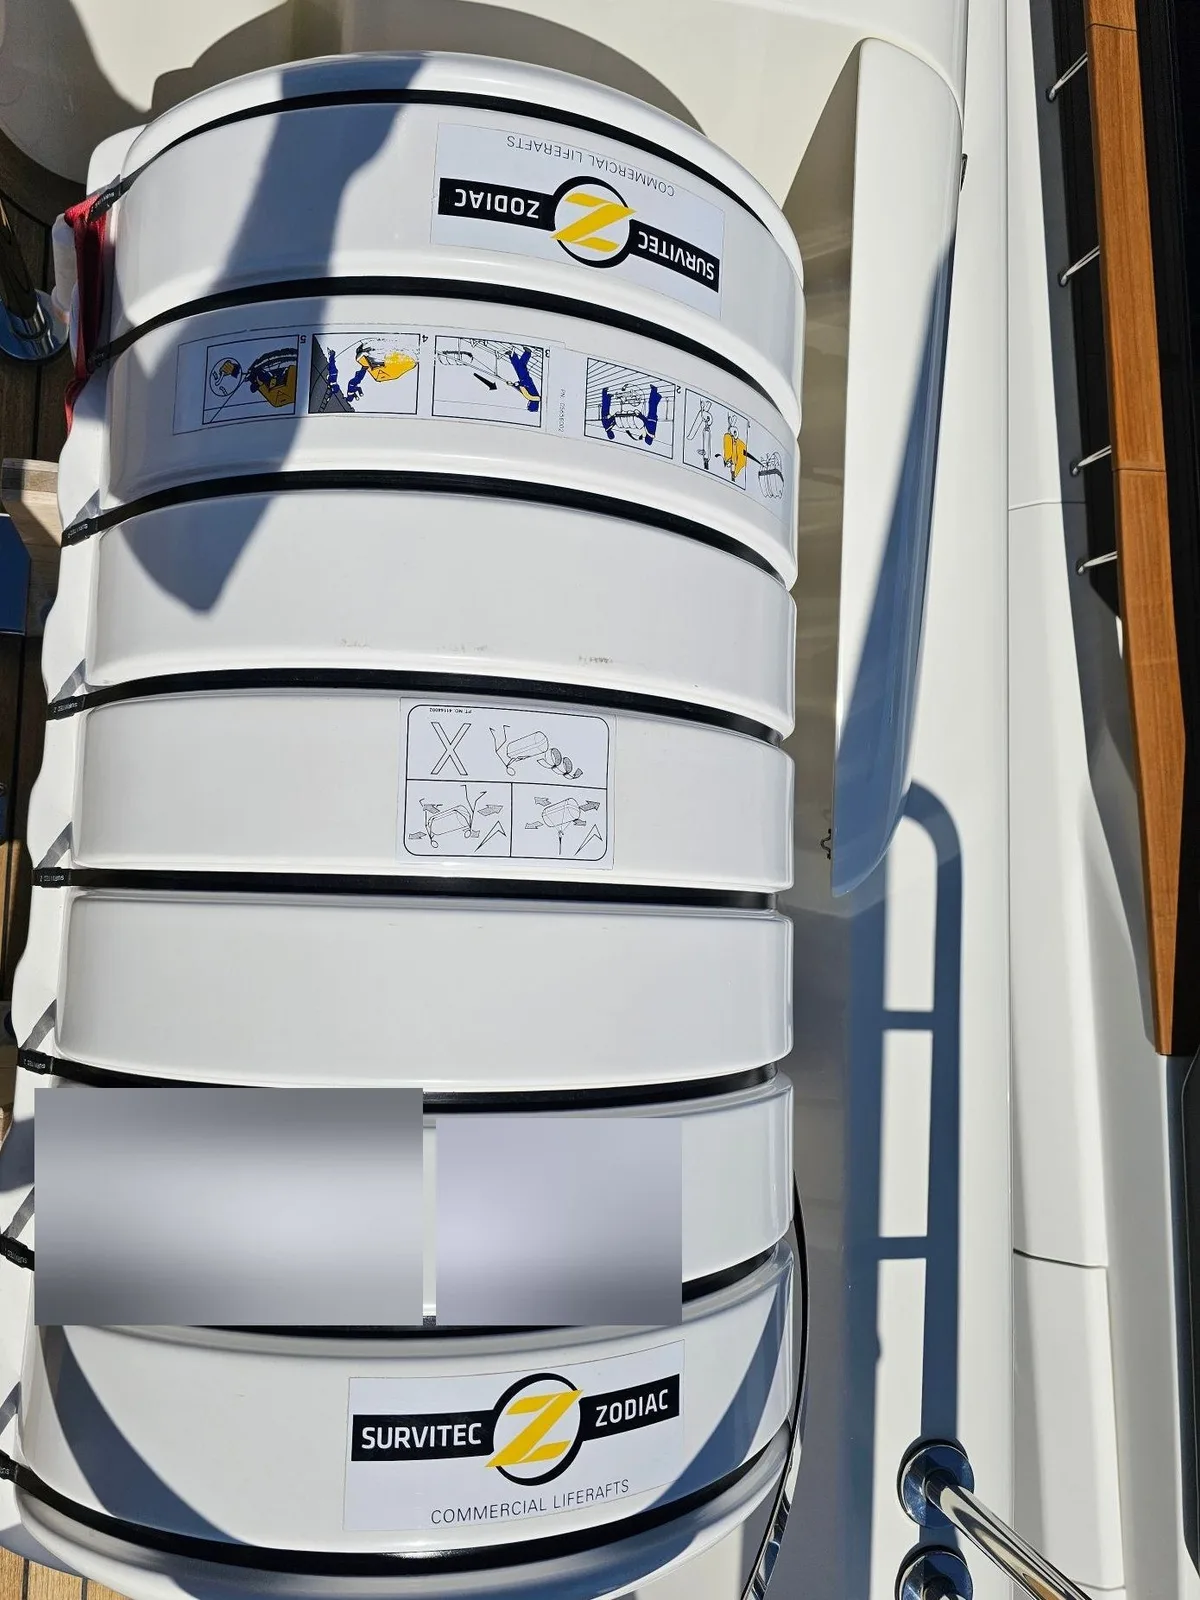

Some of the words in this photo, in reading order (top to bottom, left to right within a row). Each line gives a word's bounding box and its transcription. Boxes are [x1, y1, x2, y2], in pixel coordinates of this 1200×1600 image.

[506, 135, 583, 162] LIFERAFTS
[590, 153, 675, 197] COMMERCIAL
[454, 188, 540, 219] ZODIAC
[638, 230, 715, 281] SURVITEC
[300, 334, 306, 344] 5
[422, 334, 429, 343] 4
[545, 349, 551, 358] 3
[676, 385, 682, 394] 2
[360, 1422, 483, 1450] SURVITEC
[594, 1388, 669, 1428] ZODIAC
[430, 1498, 547, 1525] COMMERCIAL
[553, 1478, 630, 1509] LIFERAFTS
